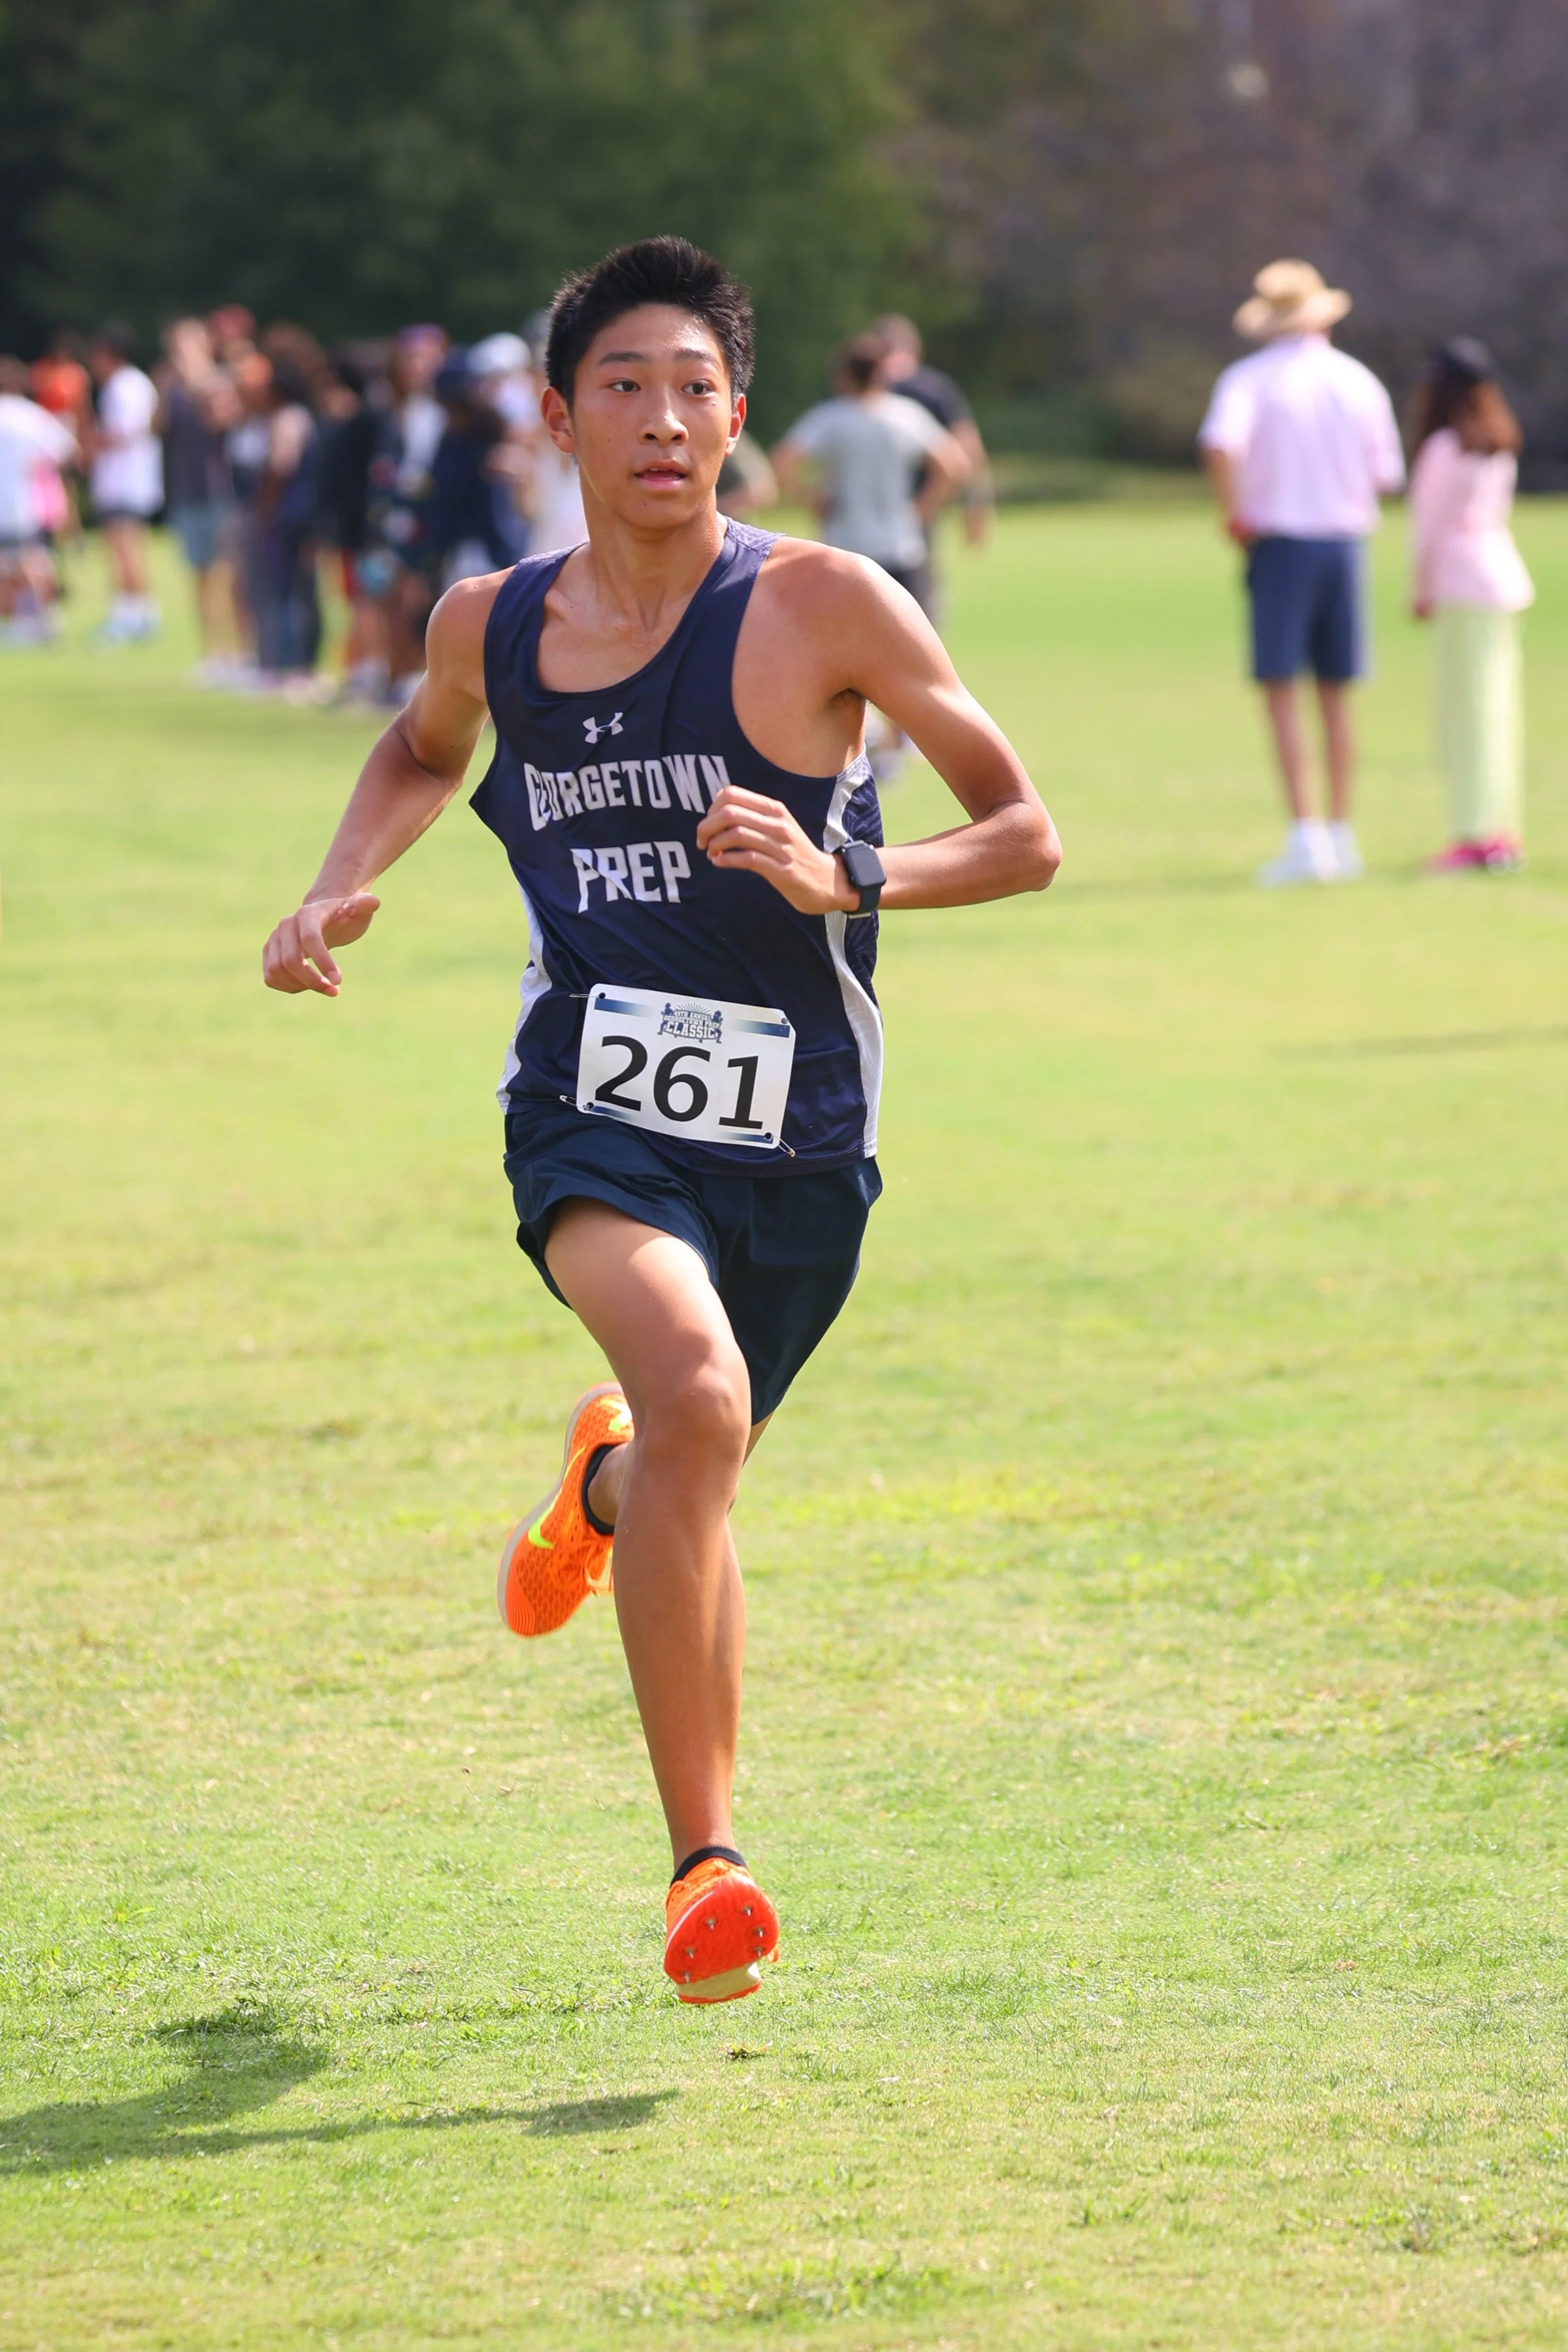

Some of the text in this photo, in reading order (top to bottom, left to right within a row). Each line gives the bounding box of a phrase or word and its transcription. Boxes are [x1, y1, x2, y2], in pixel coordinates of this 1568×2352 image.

[570, 840, 691, 913] PREP
[664, 1015, 703, 1026] GEORGETOWN
[689, 1012, 711, 1022] ANNUAL
[666, 1022, 715, 1038] CLASSIC
[595, 1035, 763, 1130] 261
